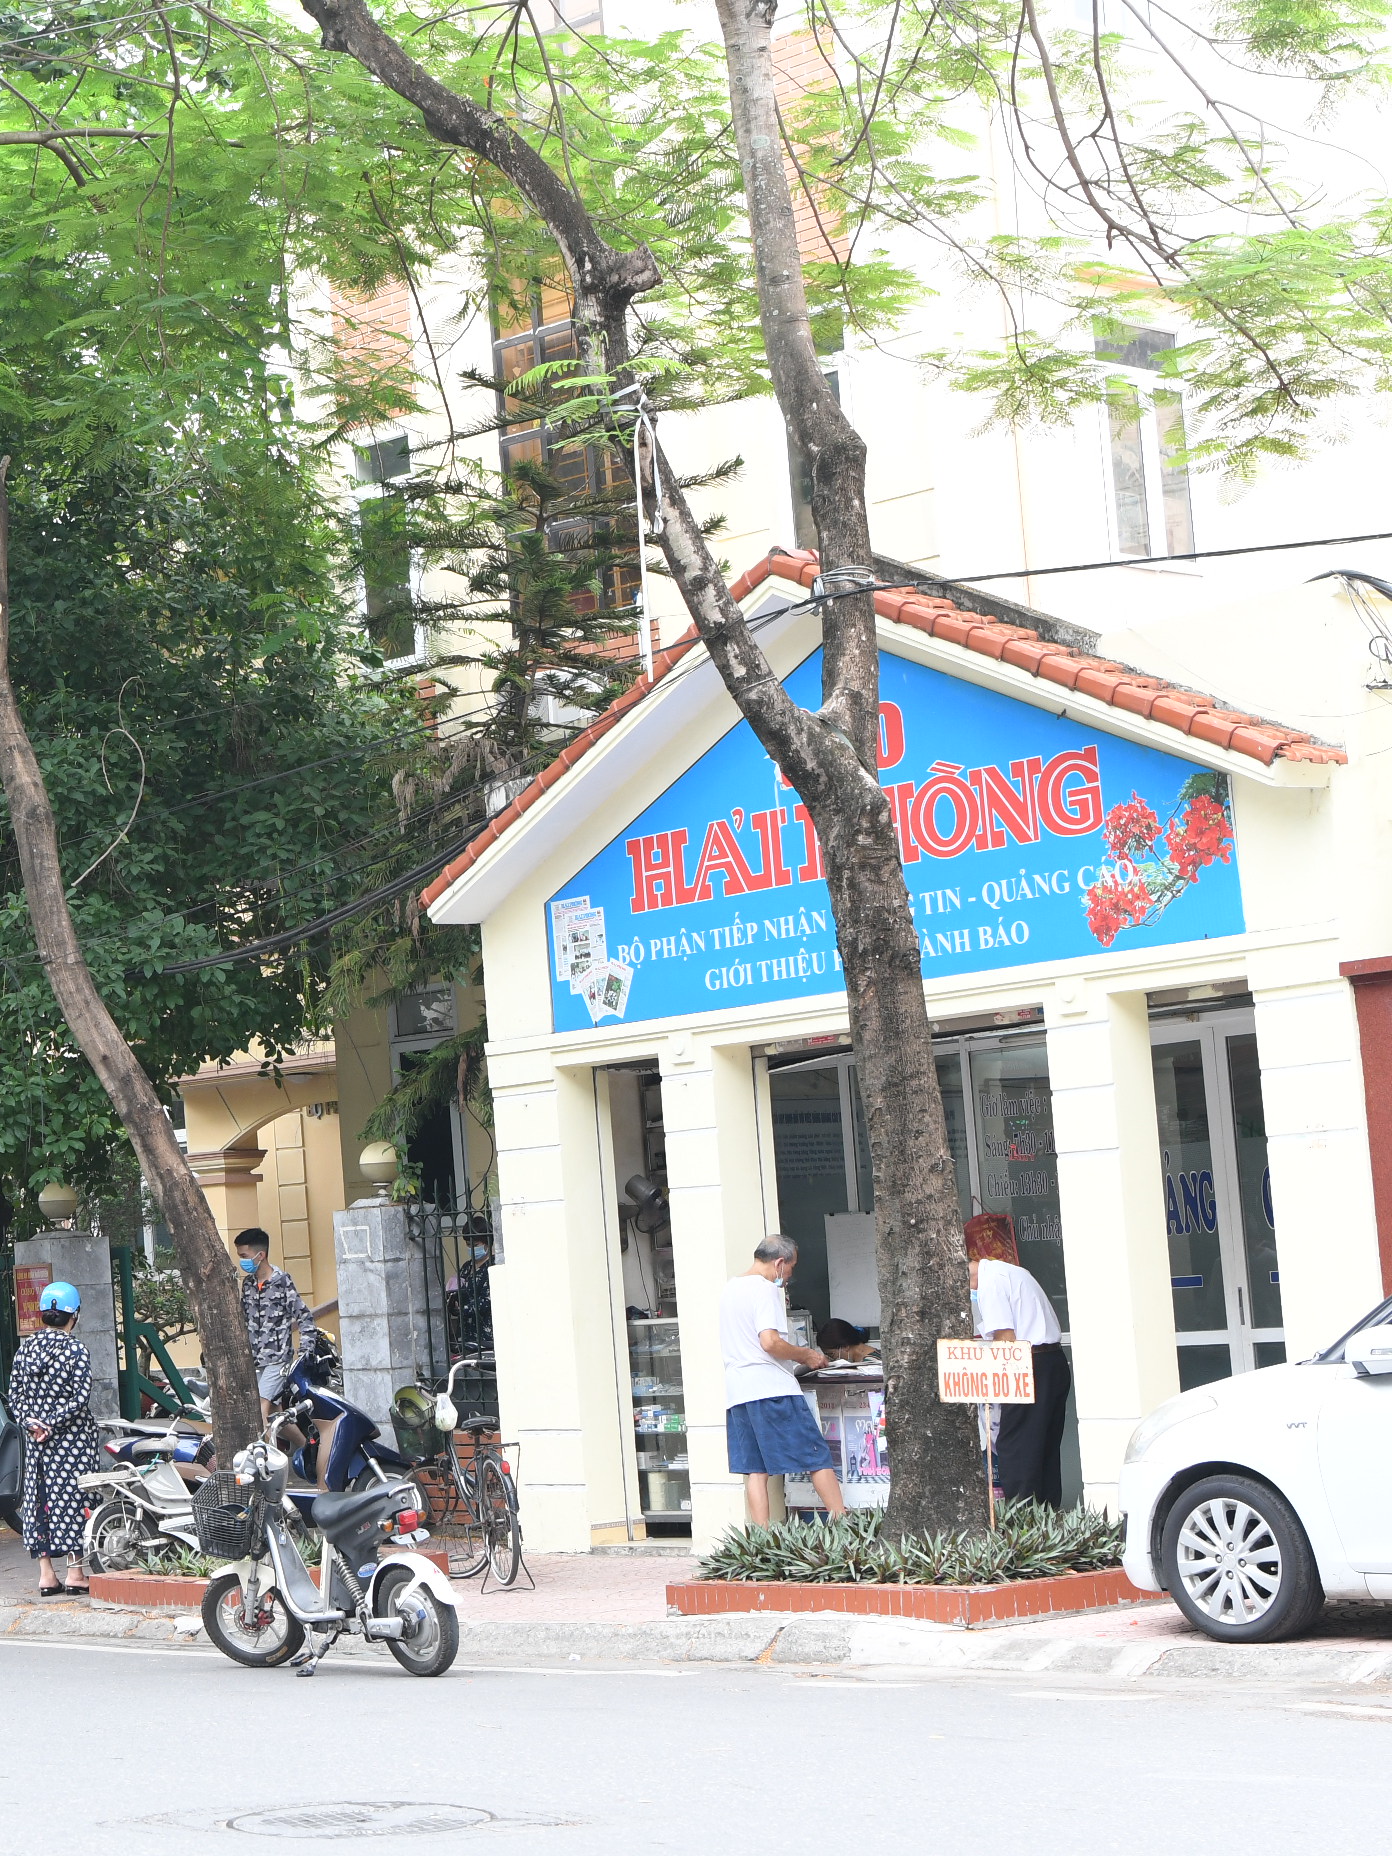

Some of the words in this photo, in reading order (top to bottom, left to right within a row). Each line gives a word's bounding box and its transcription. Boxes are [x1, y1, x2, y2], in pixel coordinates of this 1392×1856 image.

[617, 936, 645, 969] BỘ
[650, 927, 706, 961] PHẬN
[710, 911, 758, 950] TIẾP
[763, 906, 827, 942] NHẬN
[919, 887, 961, 915] TIN
[981, 869, 1071, 909] QUẢNG
[1077, 857, 1135, 894] CÁO
[705, 958, 753, 991] GIỚI
[757, 947, 826, 983] THIỆU
[977, 916, 1029, 949] BÁO
[981, 1093, 997, 1118] Giờ
[999, 1092, 1018, 1117] làm
[1020, 1090, 1041, 1120] việc
[1020, 1170, 1048, 1195] 13h30
[1018, 1215, 1039, 1242] Chủ
[1041, 1214, 1061, 1246] nhậ
[947, 1347, 984, 1360] KHU
[990, 1346, 1022, 1364] VỰC
[943, 1366, 988, 1398] KHÔNG
